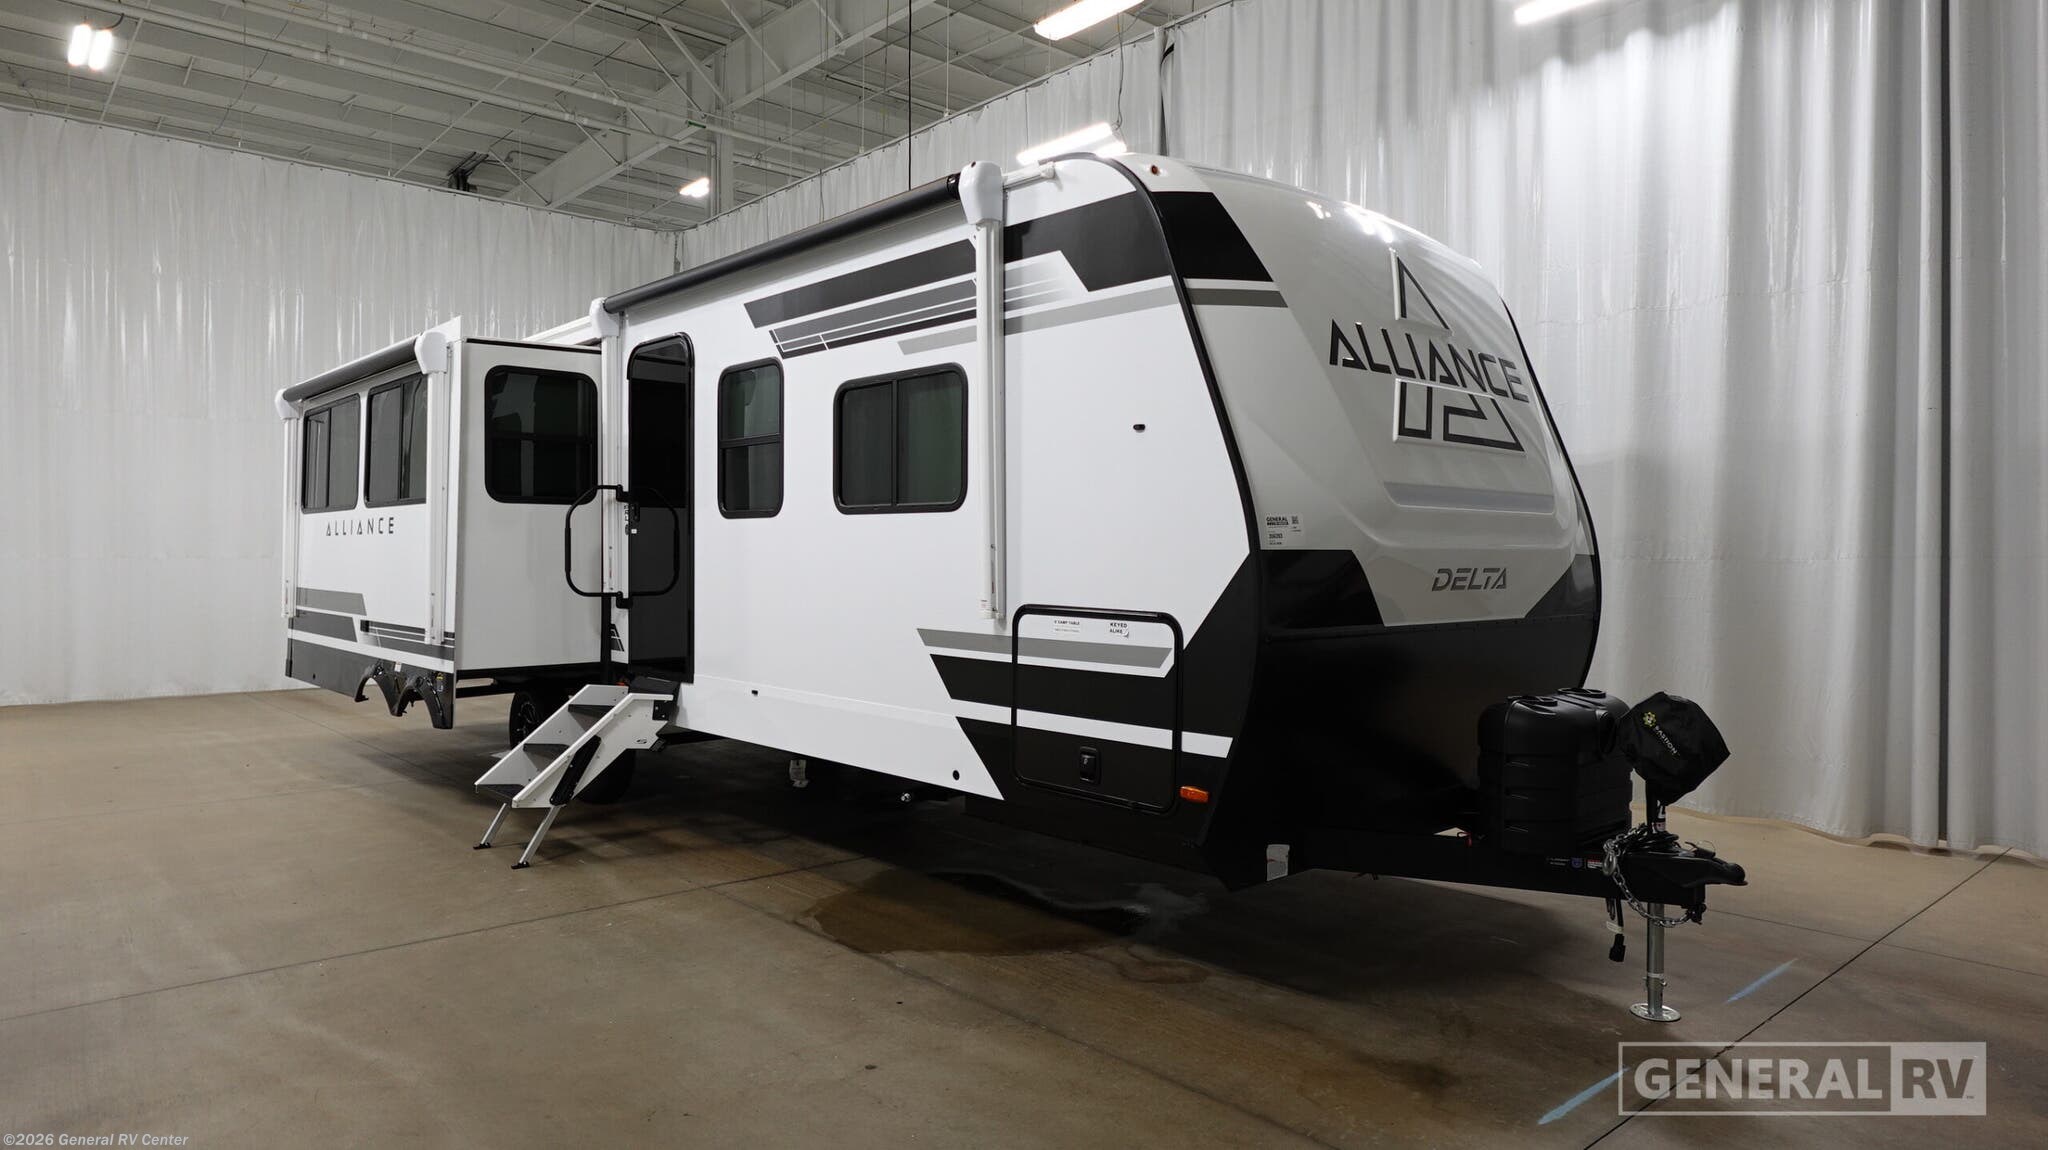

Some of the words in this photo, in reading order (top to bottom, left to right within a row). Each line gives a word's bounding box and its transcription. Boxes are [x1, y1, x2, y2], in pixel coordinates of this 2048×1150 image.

[1329, 318, 1530, 404] ALLIANCE
[326, 517, 394, 536] ALLIANCE
[1431, 567, 1507, 592] DELTA
